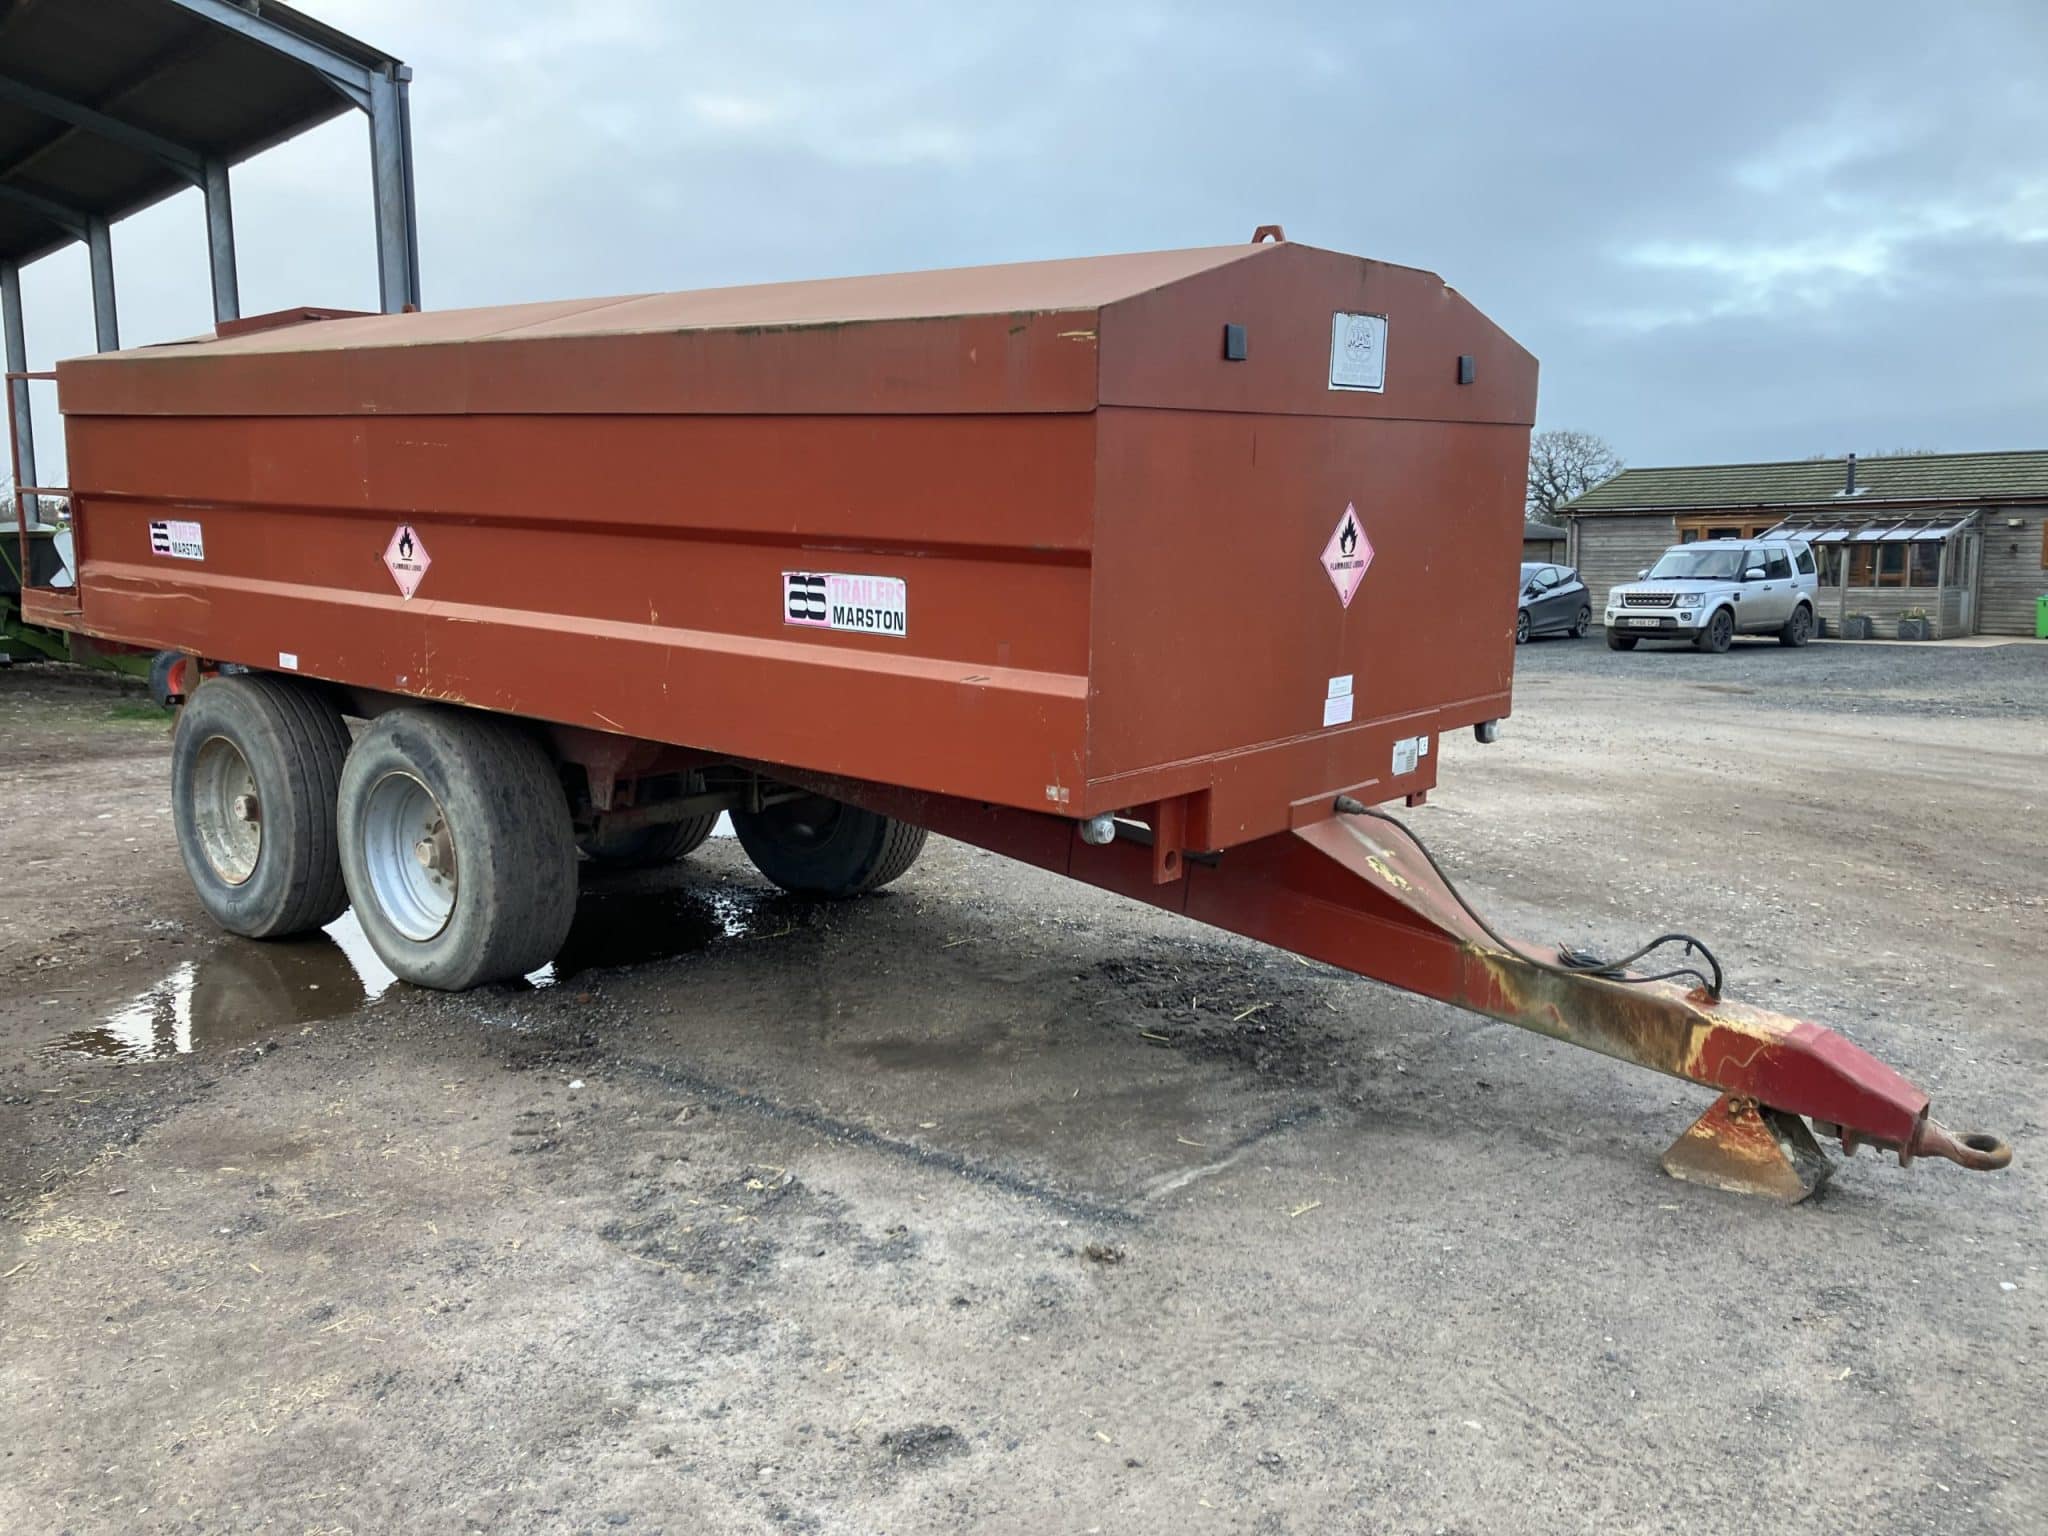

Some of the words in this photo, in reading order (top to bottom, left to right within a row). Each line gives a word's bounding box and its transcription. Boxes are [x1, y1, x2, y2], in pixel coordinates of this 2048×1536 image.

[172, 541, 202, 557] MARSTON
[832, 578, 904, 608] TRAILERS
[833, 606, 904, 630] MARSTON
